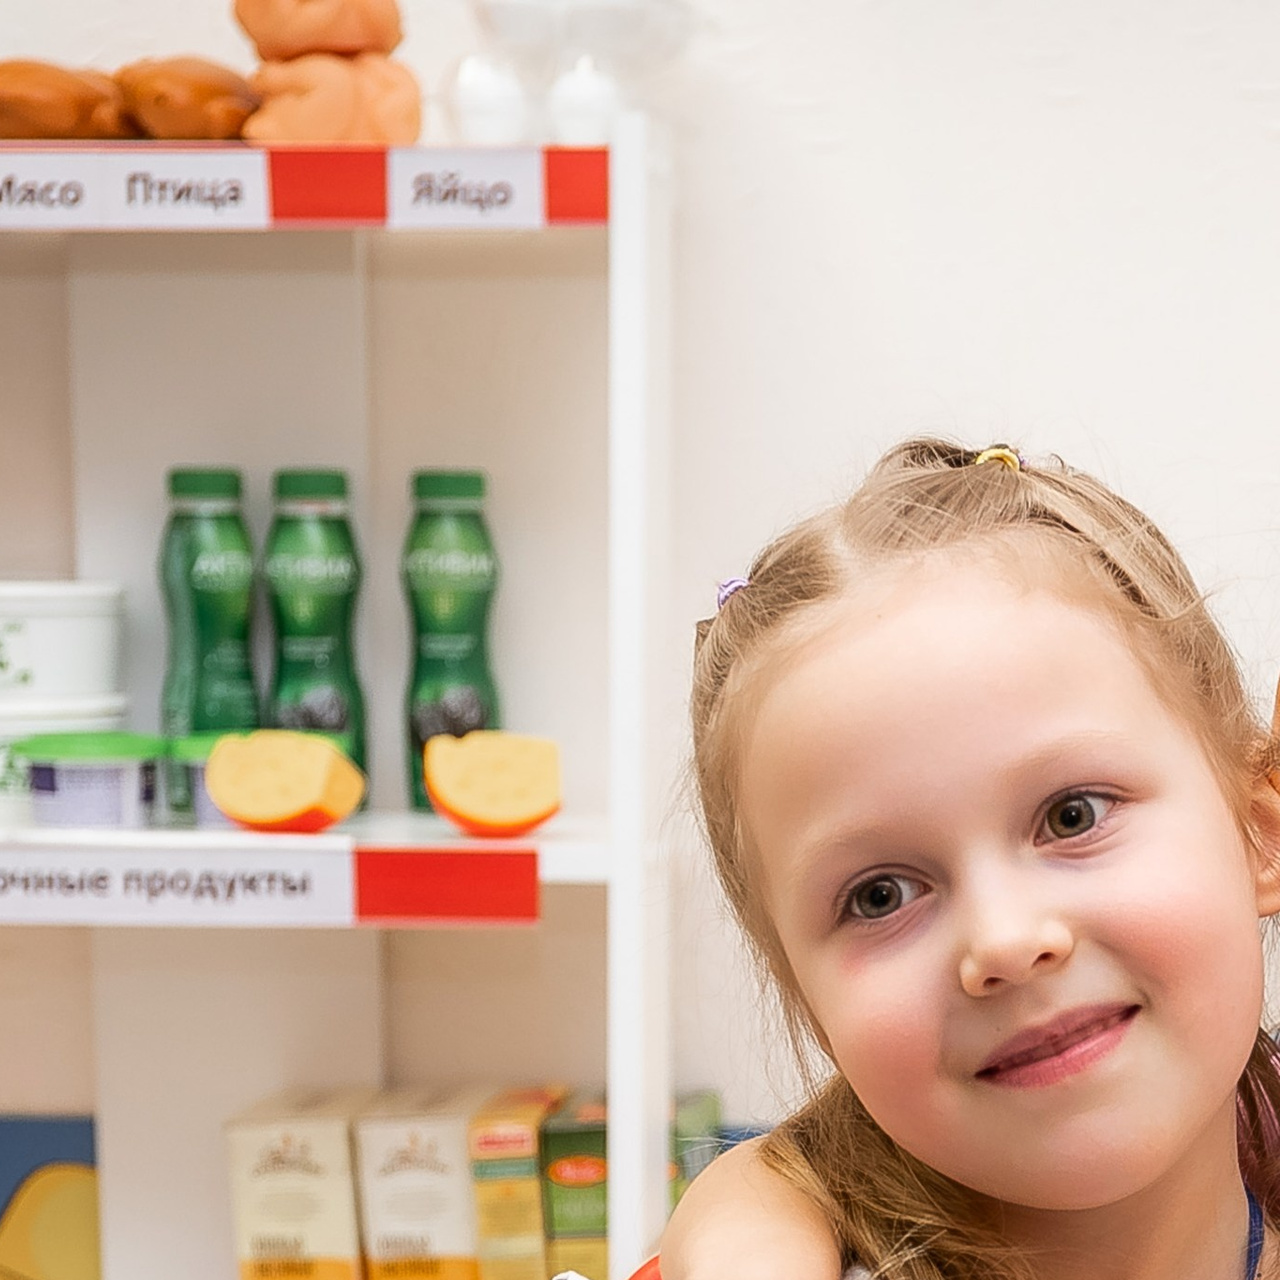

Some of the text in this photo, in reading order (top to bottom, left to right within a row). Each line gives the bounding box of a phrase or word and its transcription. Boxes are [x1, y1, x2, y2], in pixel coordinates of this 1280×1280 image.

[126, 172, 244, 212] Птица
[412, 172, 514, 212] Яйцо
[122, 869, 312, 904] продукты
